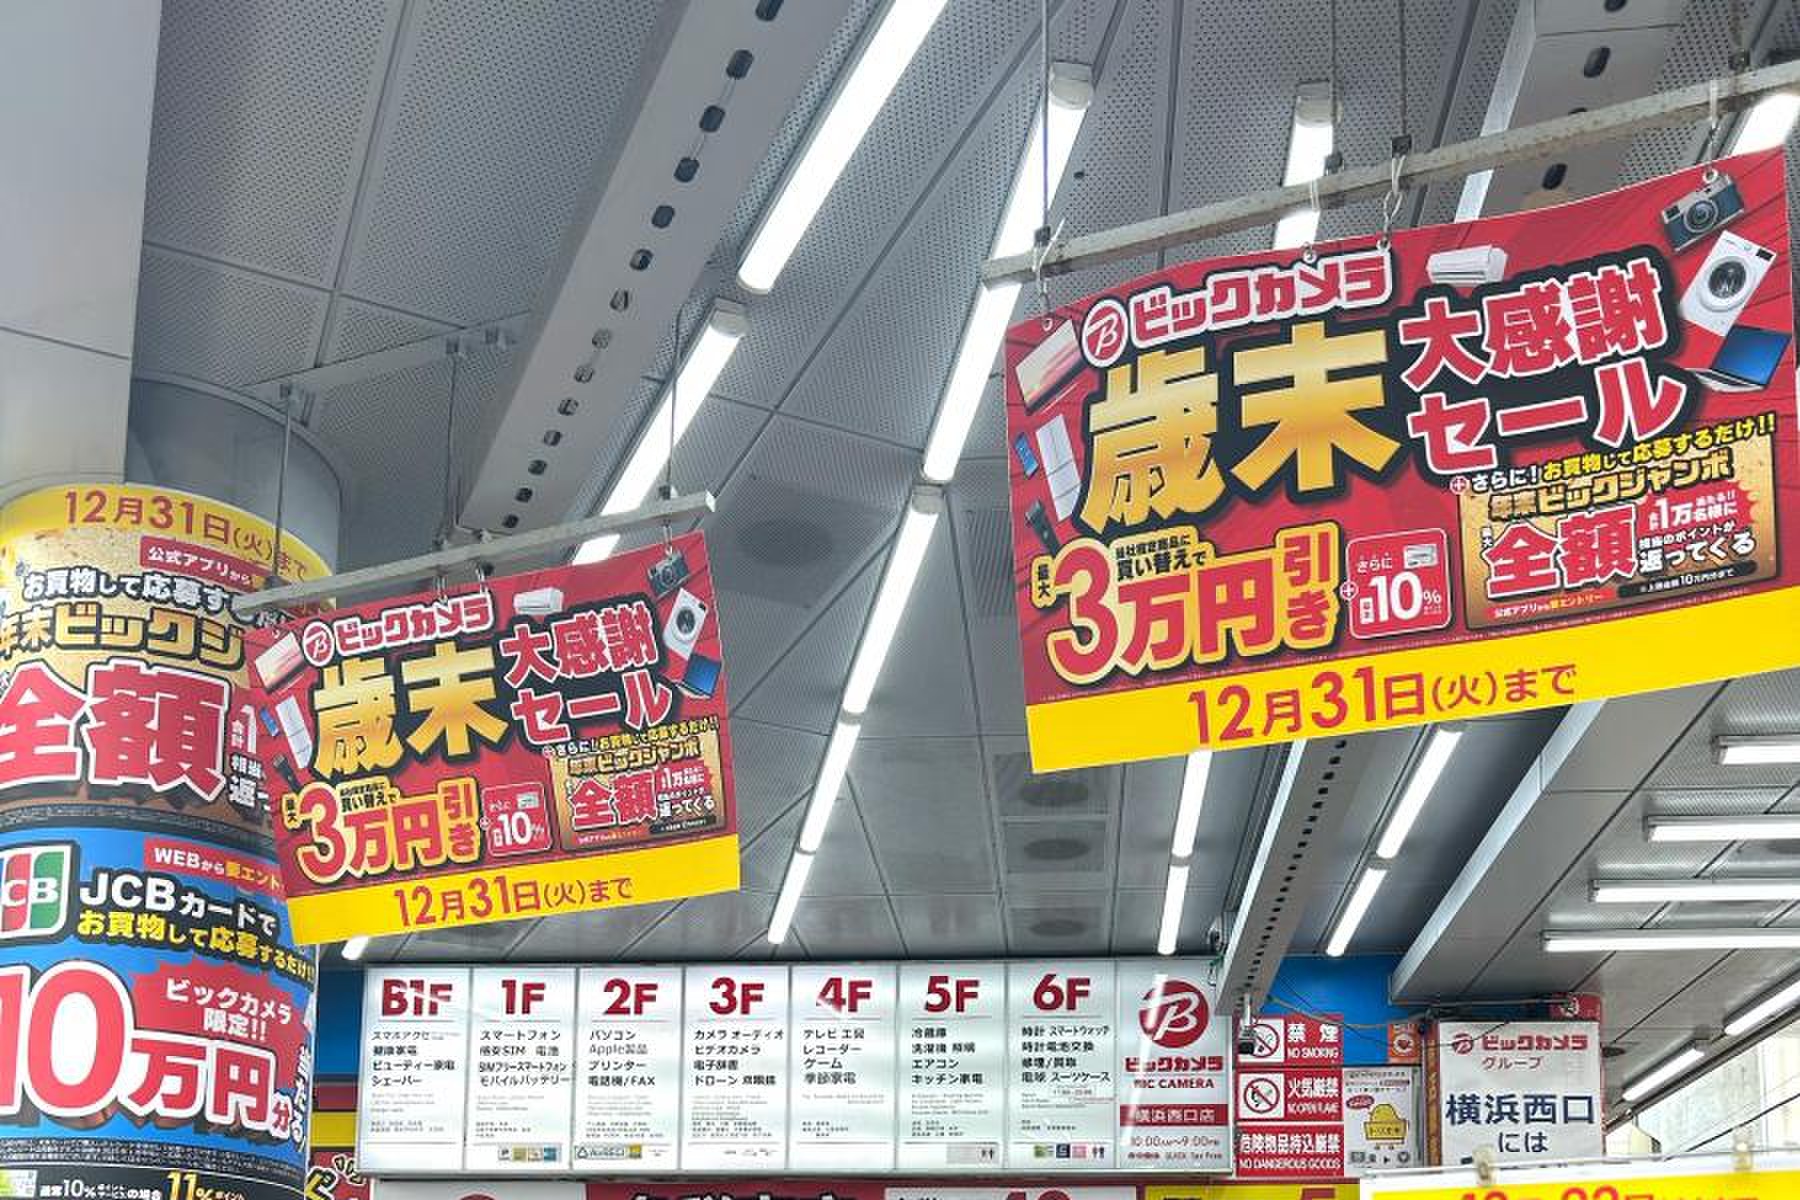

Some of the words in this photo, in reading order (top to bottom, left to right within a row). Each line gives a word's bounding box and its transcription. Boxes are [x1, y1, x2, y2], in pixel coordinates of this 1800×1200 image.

[1129, 248, 1391, 339] ビックカメラ
[1402, 260, 1666, 390] 大感謝
[1080, 324, 1401, 534] 歳末
[1405, 357, 1690, 475] セール
[1484, 506, 1638, 599] 全額
[1639, 531, 1757, 573] 返ってくる
[336, 594, 495, 654] ビックカメラ
[502, 603, 662, 687] 大感謝
[313, 644, 510, 781] 歳末
[510, 668, 675, 747] セール
[0, 658, 229, 801] 全額
[568, 769, 658, 831] 全額
[79, 871, 278, 937] JCBカードで
[166, 978, 293, 1025] ビックカメラ
[500, 978, 546, 1016] 1F
[602, 977, 659, 1016] 2F
[708, 976, 766, 1016] 3F
[816, 977, 874, 1016] 4F
[923, 975, 980, 1013] 5F
[1032, 973, 1092, 1012] 6F
[479, 1029, 561, 1041] スマートフォン
[589, 1029, 637, 1041] パソコン
[589, 1043, 649, 1057] Apple製品
[693, 1029, 728, 1041] カメラ
[730, 1029, 785, 1041] オーディオ
[693, 1044, 761, 1056] ビデオカメラ
[802, 1027, 838, 1040] テレビ
[802, 1043, 863, 1055] レコーダー
[1287, 1023, 1340, 1044] 禁煙
[1481, 1034, 1588, 1051] ビックカメラ
[371, 1074, 423, 1087] シェーバー
[587, 1074, 656, 1088] 電話機/FAX
[588, 1059, 647, 1072] プリンター
[693, 1075, 739, 1087] ドローン
[802, 1057, 843, 1070] ゲーム
[911, 1058, 960, 1070] エアコン
[1050, 1071, 1111, 1084] スーツケース
[1481, 1056, 1545, 1071] グループ
[1158, 1078, 1216, 1089] CAMERA
[1445, 1093, 1596, 1126] 横浜西口
[1498, 1130, 1549, 1155] には
